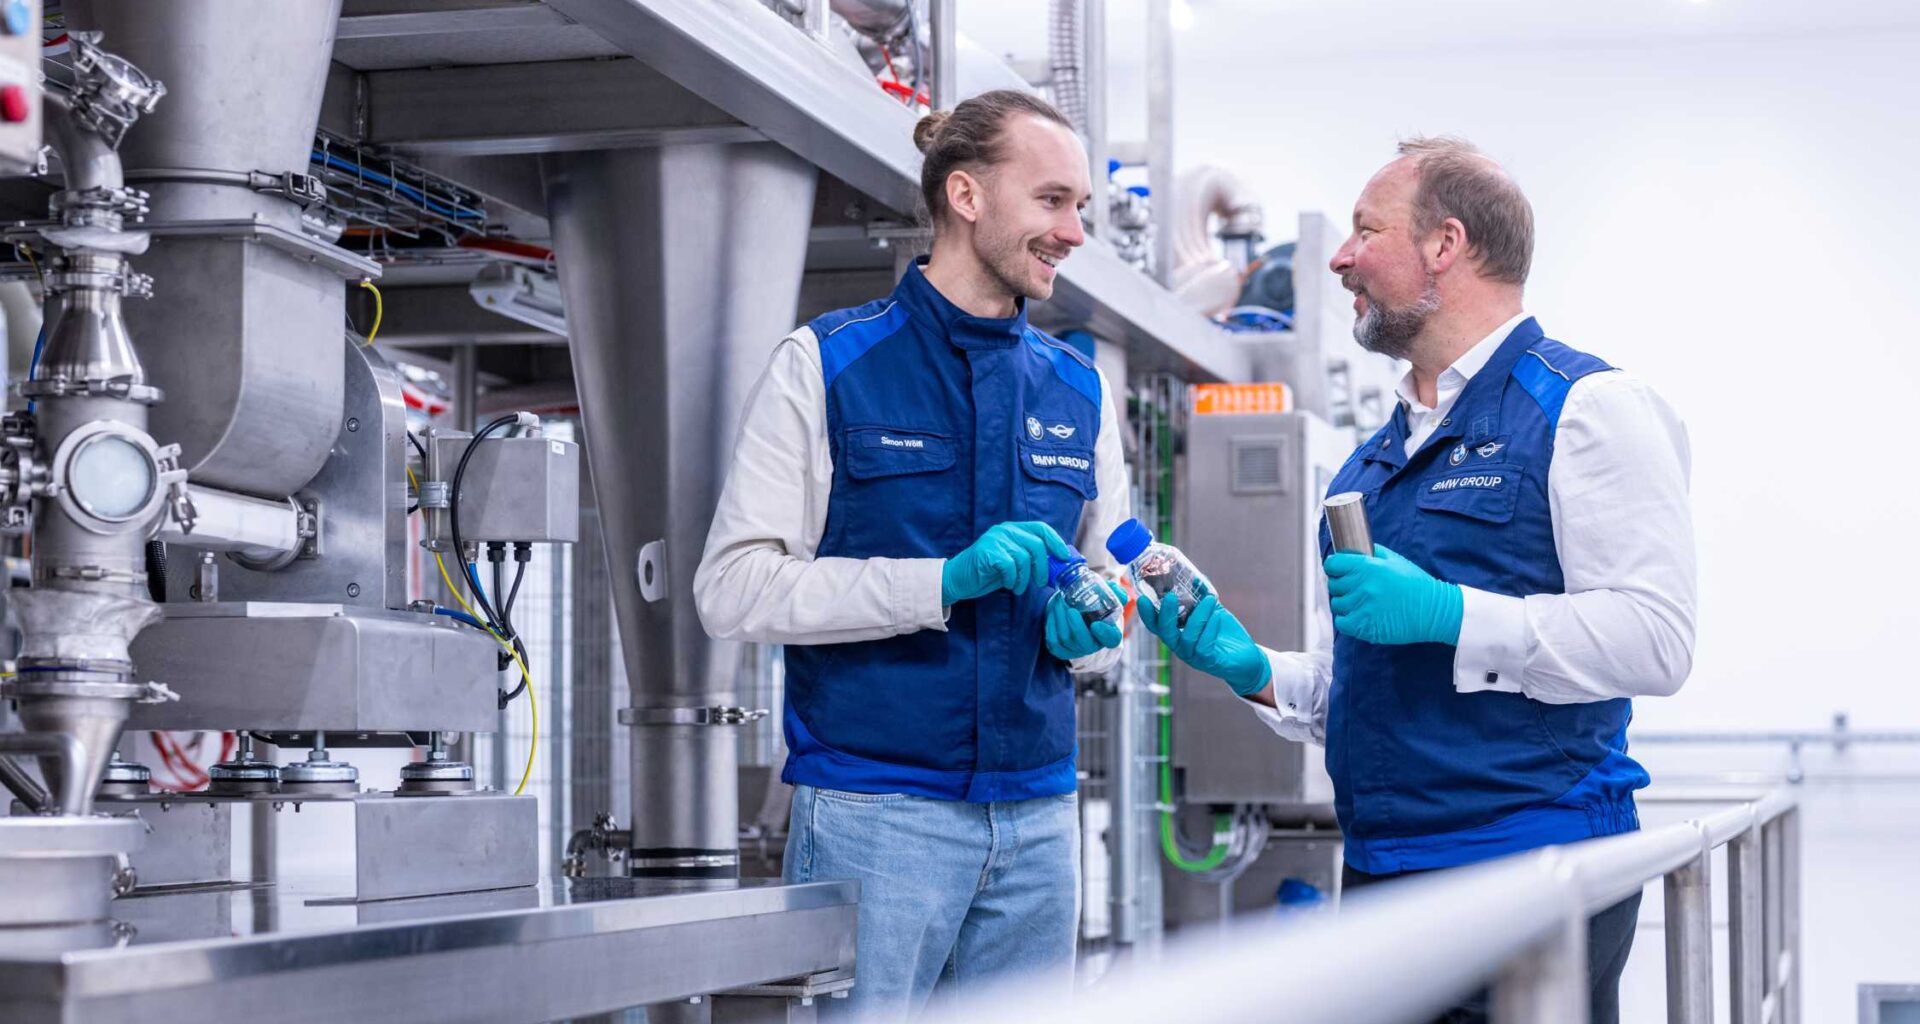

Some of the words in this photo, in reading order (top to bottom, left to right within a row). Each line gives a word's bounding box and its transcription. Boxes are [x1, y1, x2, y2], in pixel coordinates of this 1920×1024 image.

[881, 436, 903, 446] Simon
[1031, 453, 1057, 466] BMW
[1057, 455, 1090, 470] GROUP
[1432, 478, 1460, 490] BMW
[1459, 476, 1502, 487] GROUP
